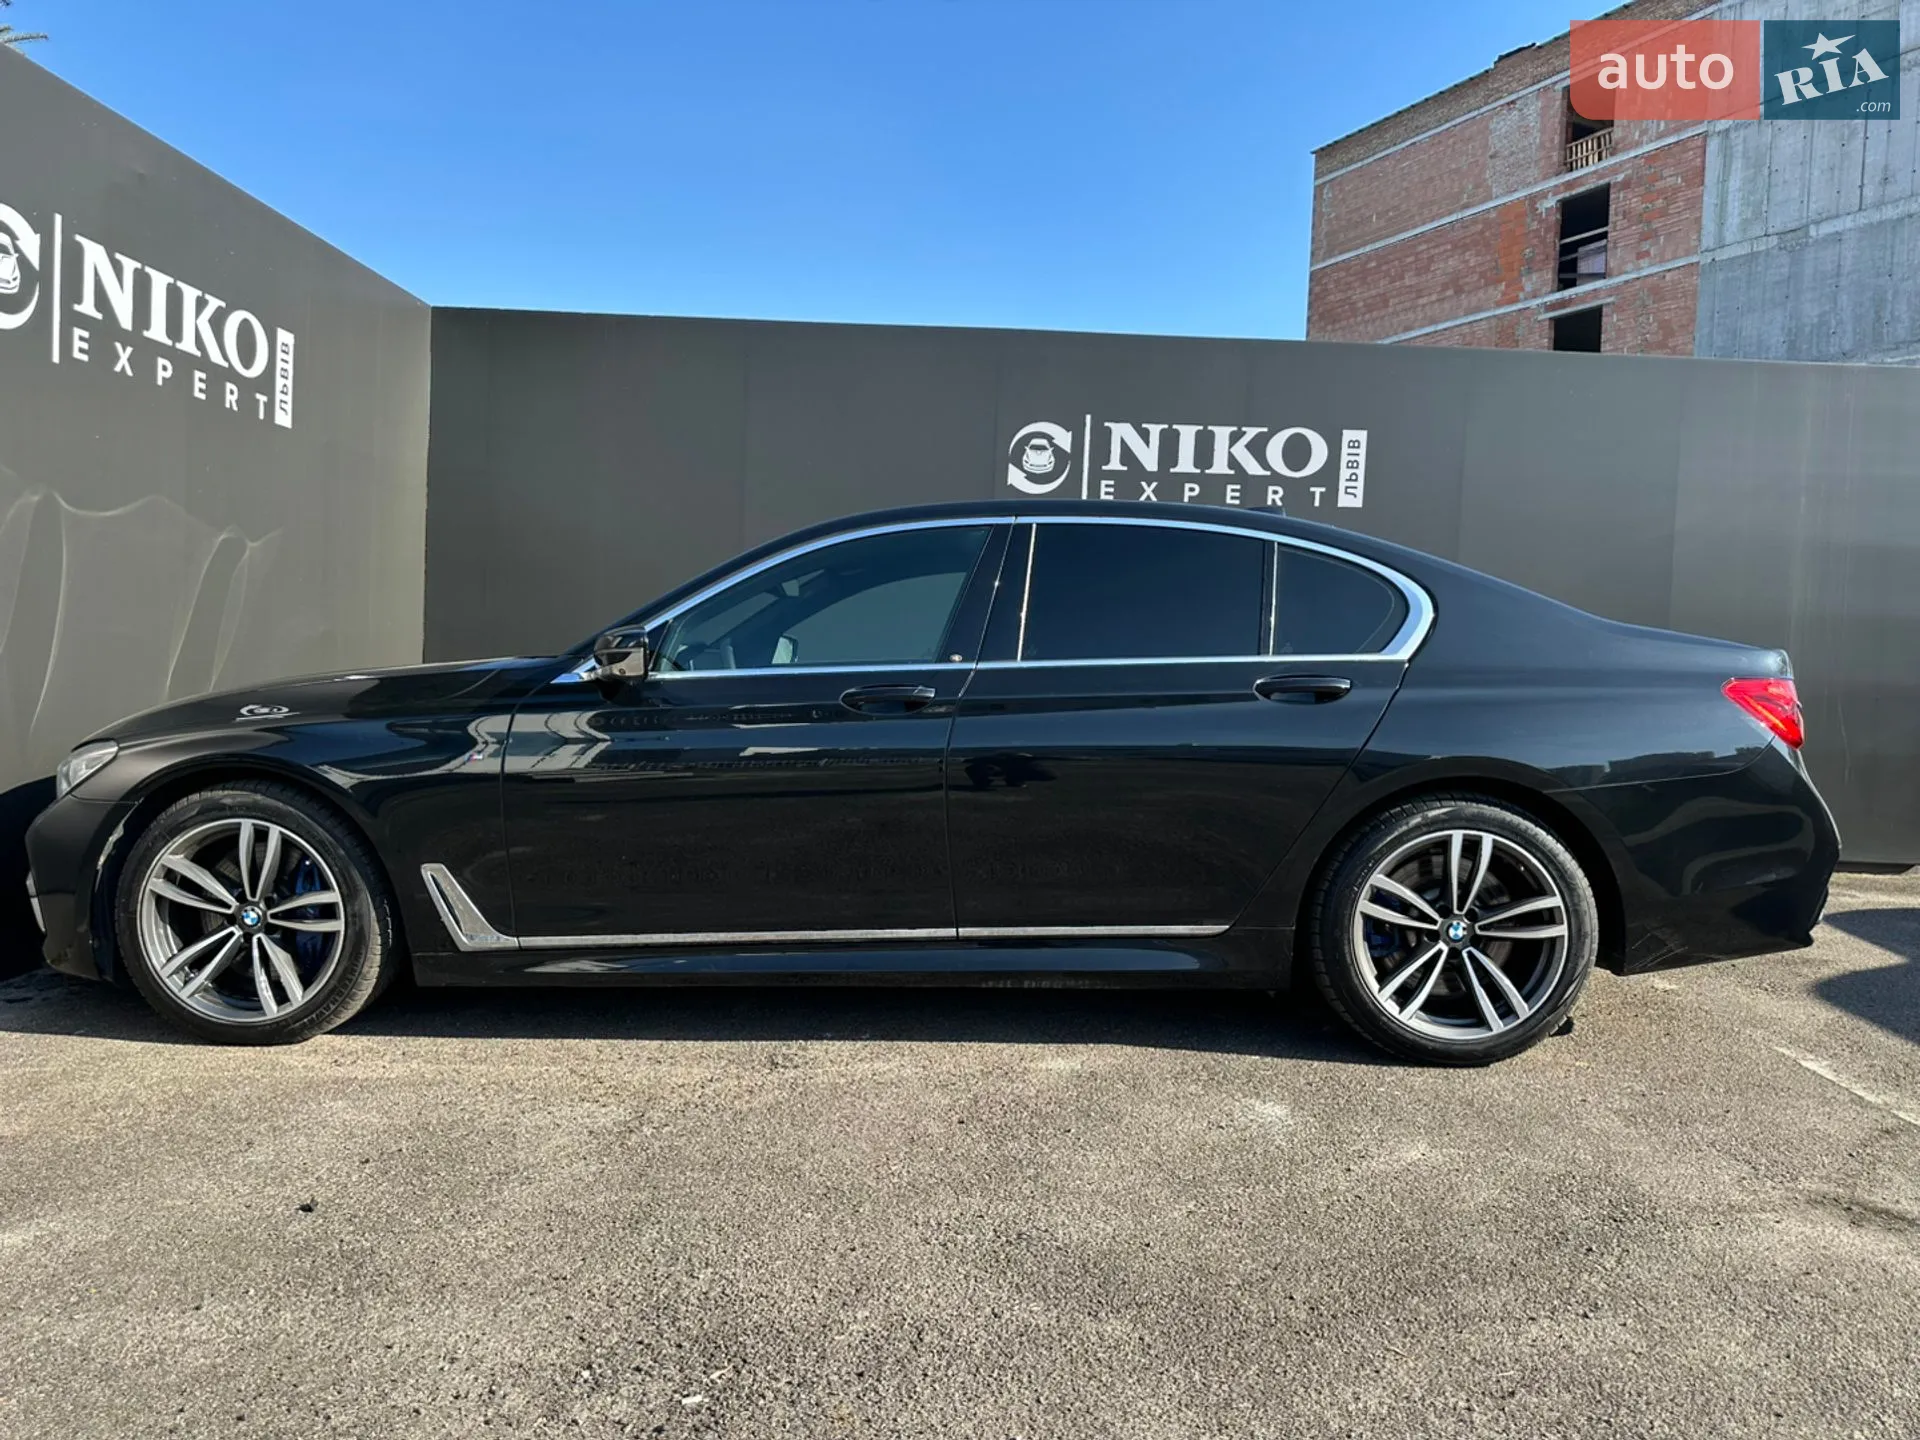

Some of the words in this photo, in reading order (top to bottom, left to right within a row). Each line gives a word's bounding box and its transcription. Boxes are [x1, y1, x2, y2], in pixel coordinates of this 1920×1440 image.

[73, 234, 270, 379] NIKO
[72, 326, 269, 421] EXPERT
[1101, 421, 1329, 479] NIKO
[1343, 438, 1362, 499] ЛЬВІВ
[1099, 479, 1327, 508] EXPERT
